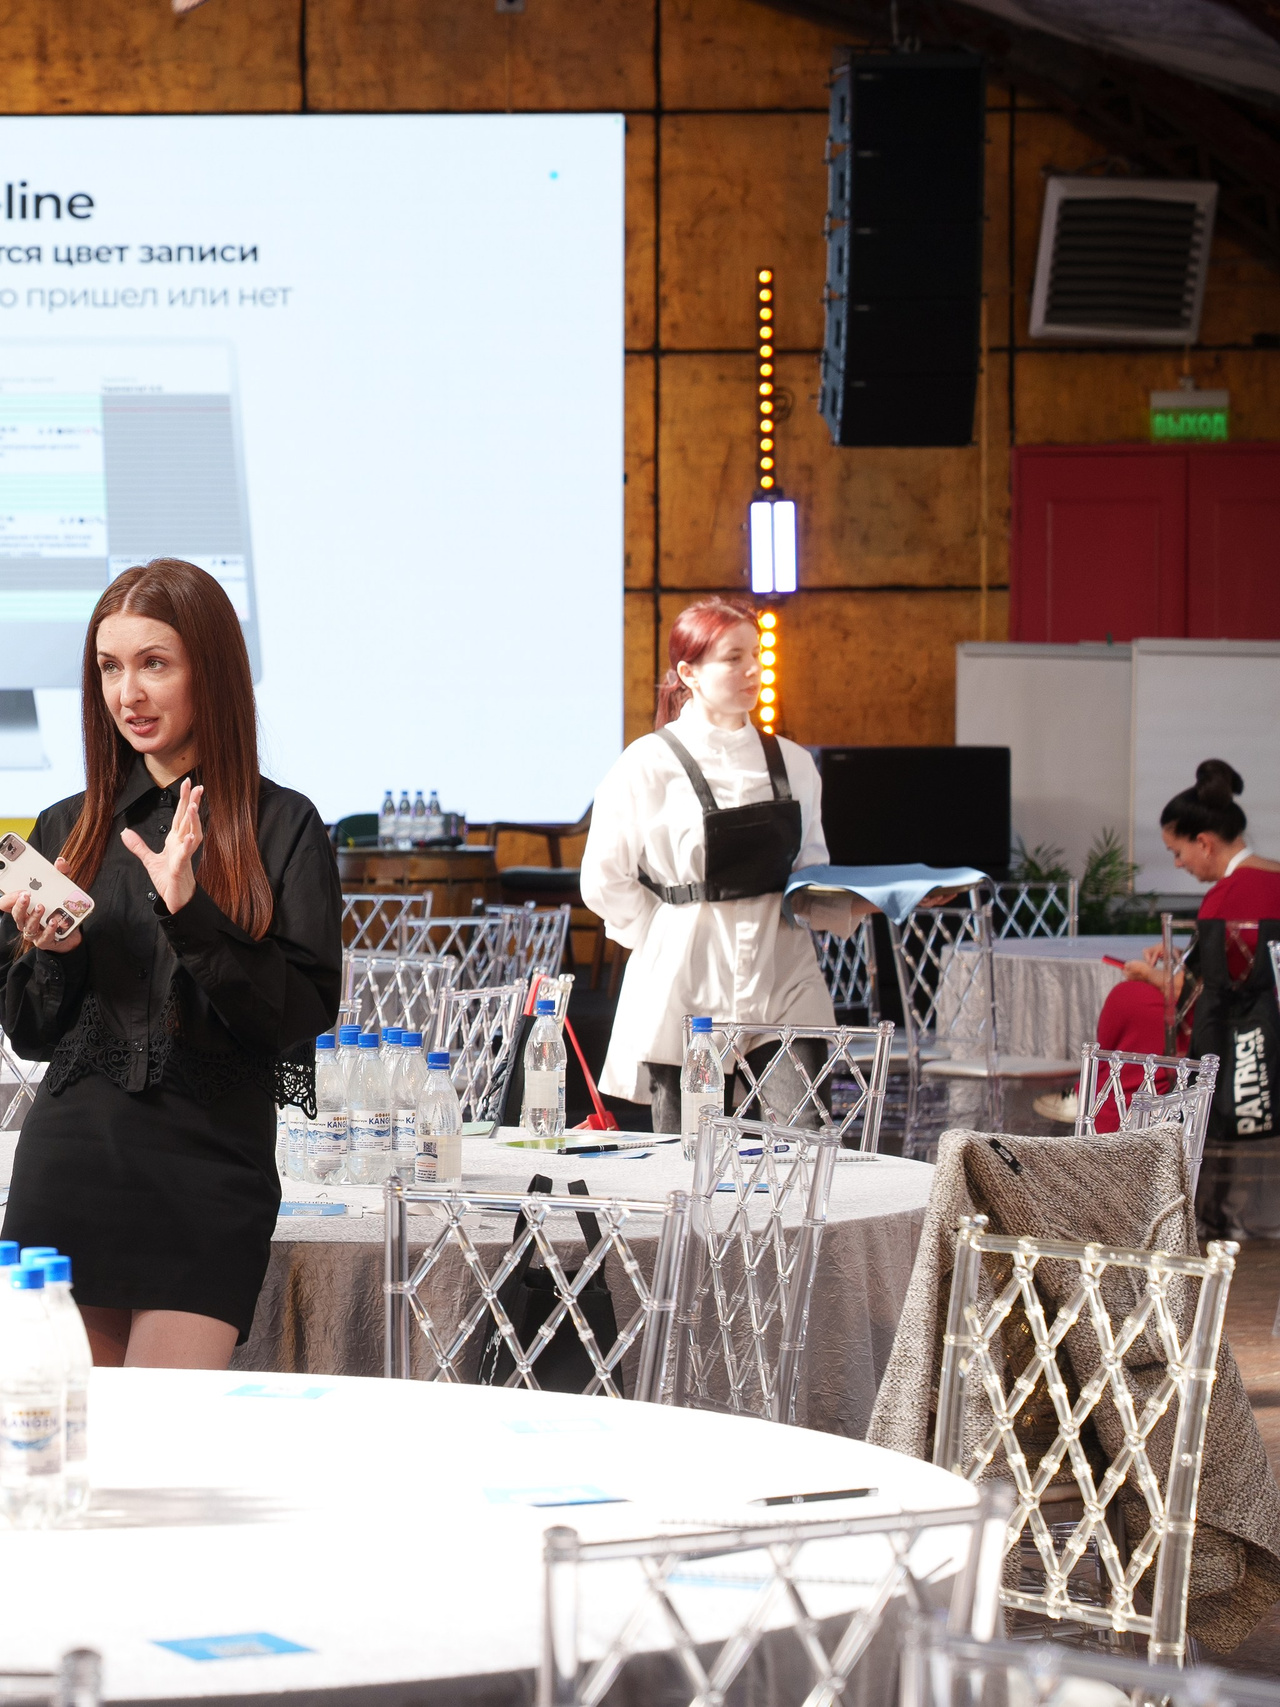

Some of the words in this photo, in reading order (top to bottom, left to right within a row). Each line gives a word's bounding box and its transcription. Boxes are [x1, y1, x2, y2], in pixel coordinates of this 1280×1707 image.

[52, 244, 131, 269] цвет
[137, 243, 260, 265] записи
[26, 287, 158, 313] пришел
[168, 287, 229, 308] или
[238, 286, 292, 308] нет
[1153, 412, 1227, 440] ВЫХОД
